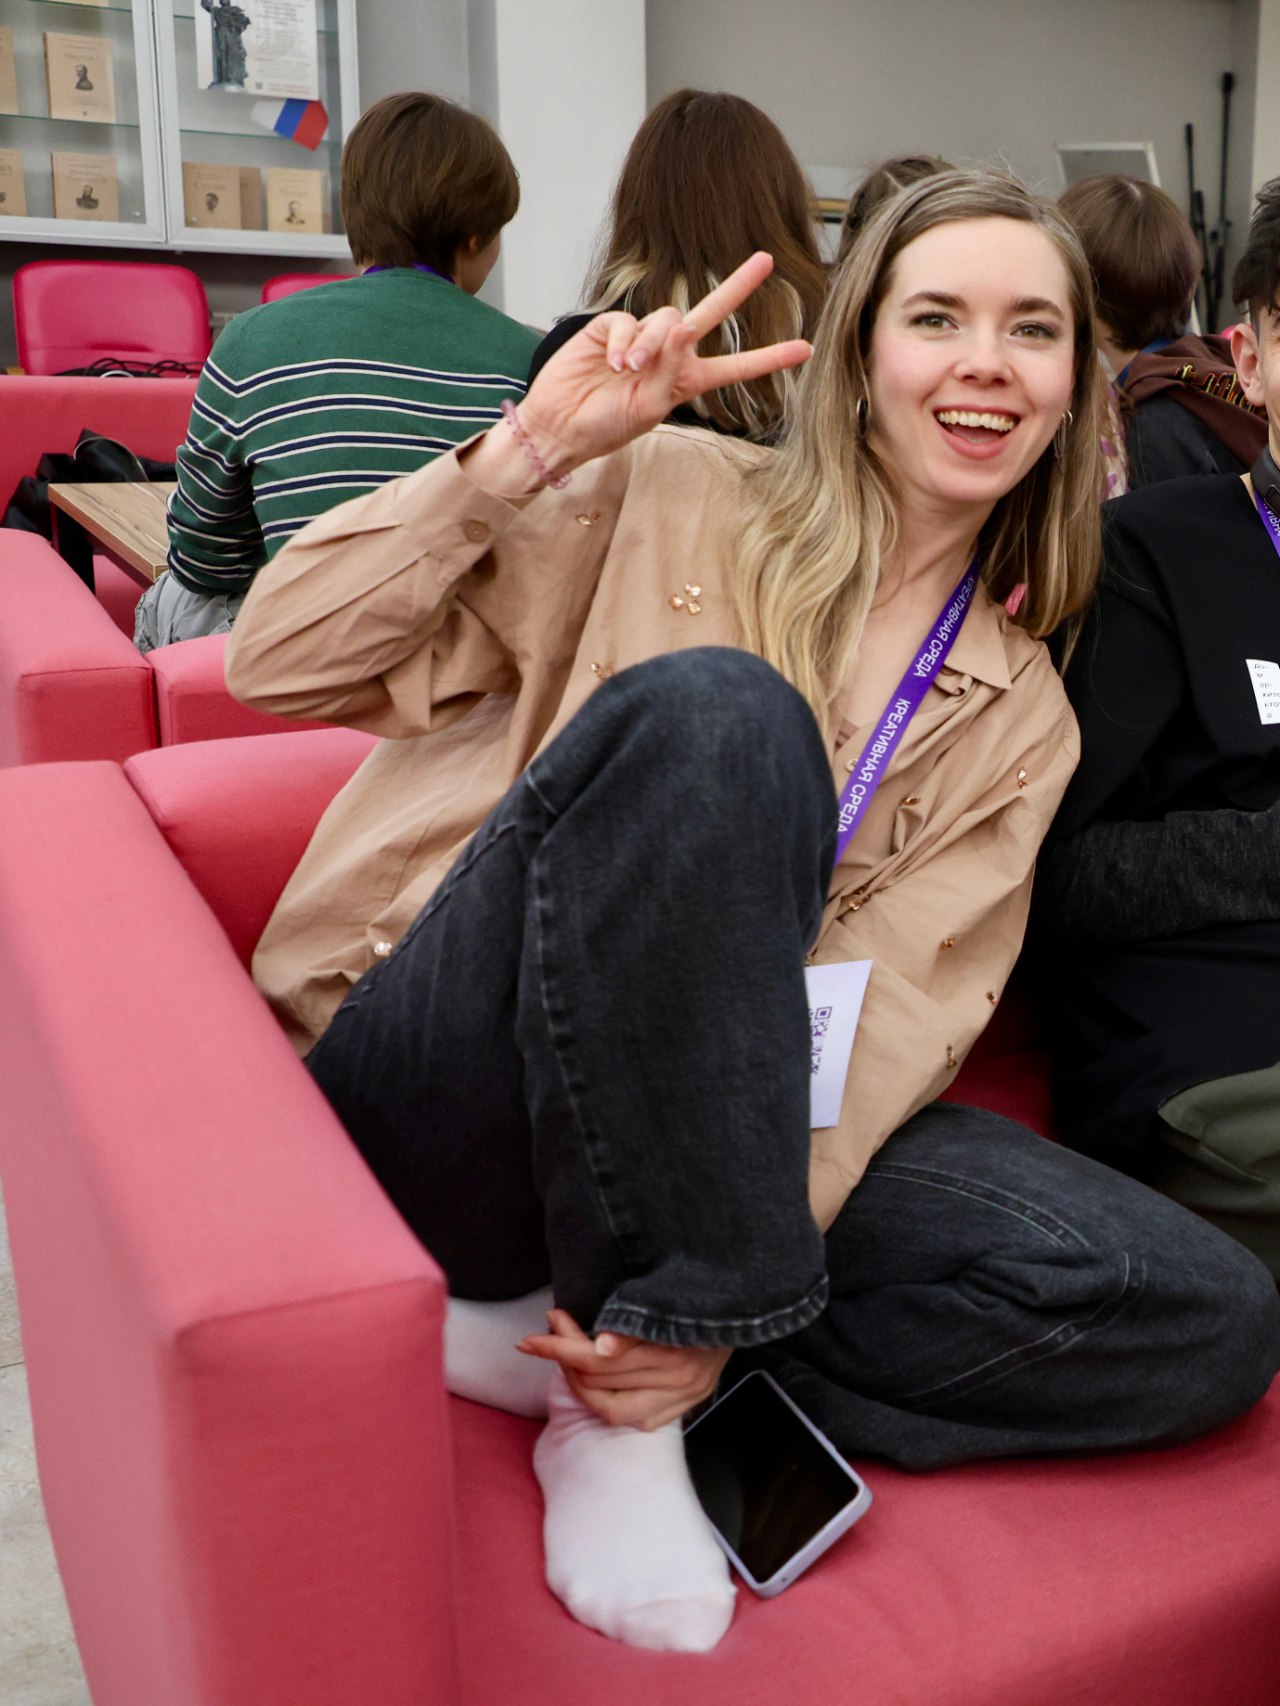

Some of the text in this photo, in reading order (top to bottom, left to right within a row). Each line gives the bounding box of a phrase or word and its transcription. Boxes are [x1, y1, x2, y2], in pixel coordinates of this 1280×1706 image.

[913, 575, 974, 678] КРЕАТИВНАЯ СРЕДА
[837, 698, 911, 833] КРЕАТИВНАЯ СРЕДА
